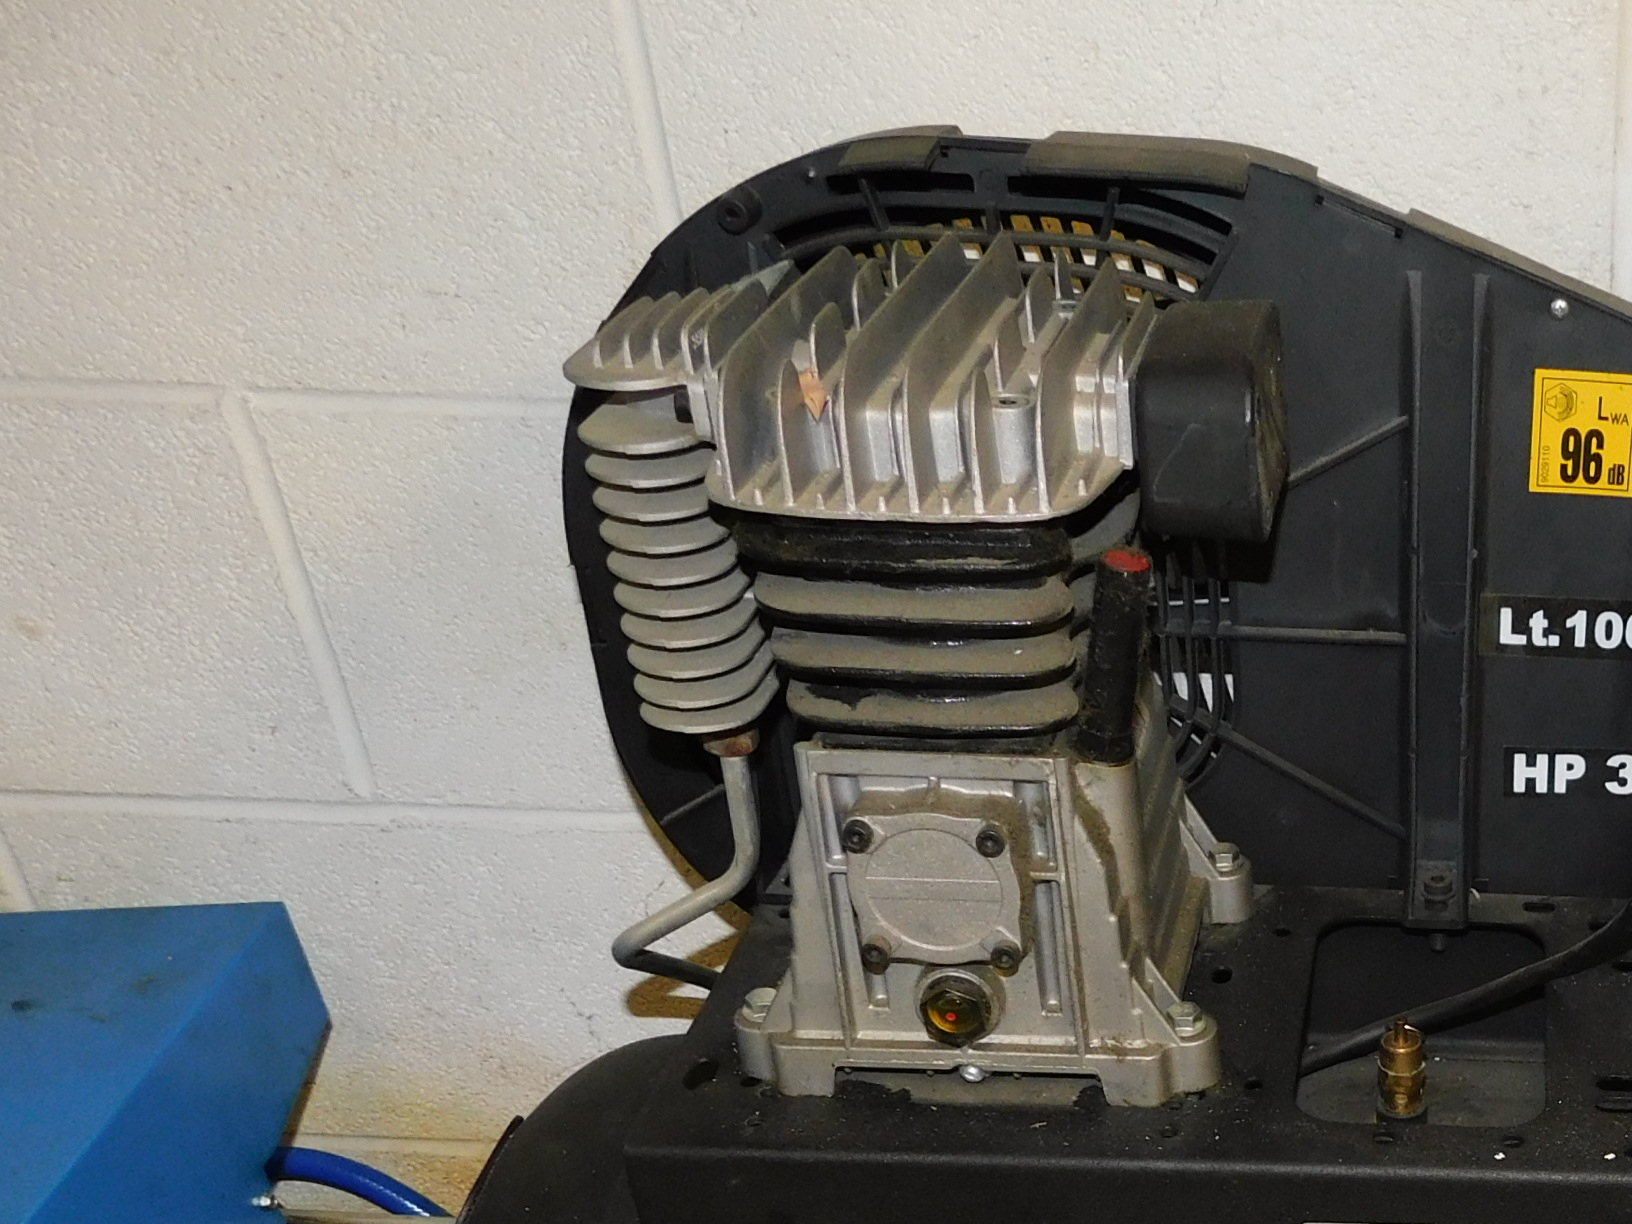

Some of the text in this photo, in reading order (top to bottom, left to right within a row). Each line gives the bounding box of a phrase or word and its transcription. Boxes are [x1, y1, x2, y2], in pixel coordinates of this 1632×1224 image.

[1560, 427, 1626, 485] 96 dB
[1513, 753, 1586, 795] HP
